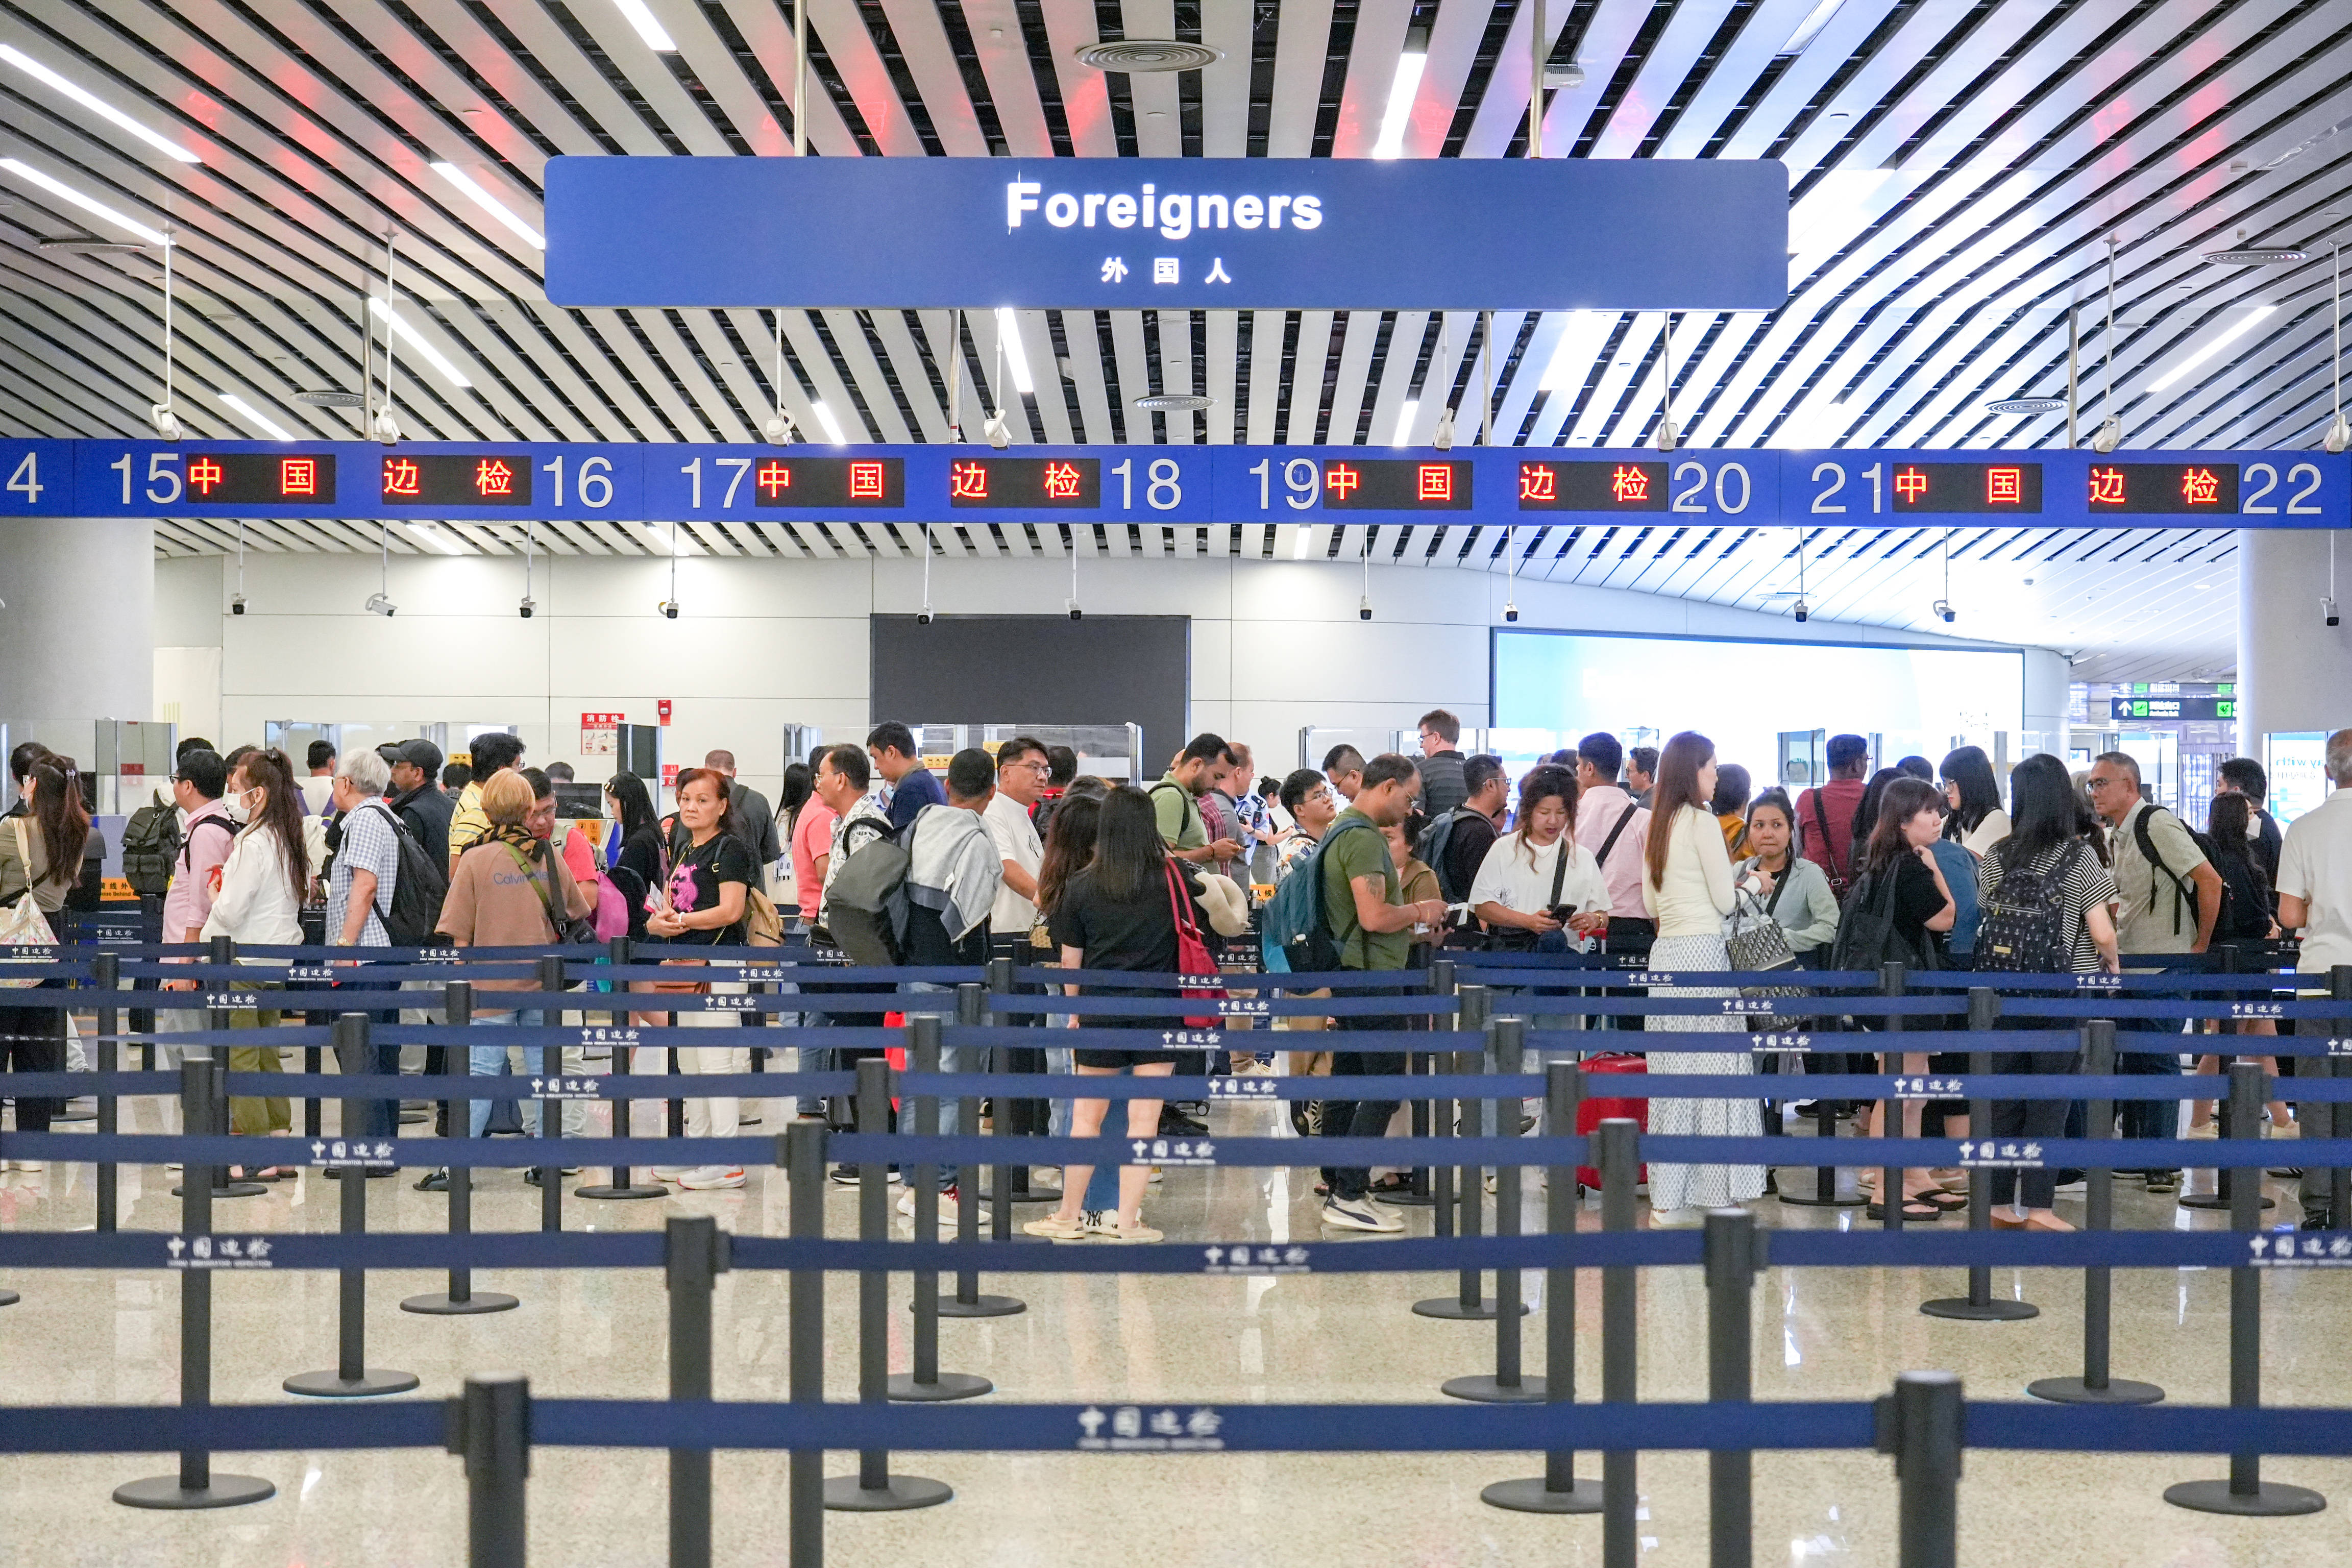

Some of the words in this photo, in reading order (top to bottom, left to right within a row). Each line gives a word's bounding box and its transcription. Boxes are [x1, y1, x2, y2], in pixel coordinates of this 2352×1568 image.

[1008, 182, 1322, 239] Foreigners
[1101, 257, 1231, 284] 外国人
[111, 453, 182, 504] 15
[189, 457, 316, 496] 中国
[384, 458, 513, 496] 边检
[544, 455, 613, 508] 16
[681, 457, 751, 508] 17
[757, 460, 885, 499] 中国
[952, 461, 1081, 499] 边检
[1326, 463, 1453, 501] 中国
[1521, 464, 1650, 502] 边检
[1112, 458, 1182, 510] 18
[1250, 458, 1319, 510] 19
[1672, 461, 1751, 514] 20
[1811, 462, 1881, 513] 21
[1895, 466, 2022, 504] 中国
[2090, 467, 2219, 505] 边检
[2242, 463, 2322, 514] 22
[586, 714, 620, 723] 消防栓
[96, 928, 133, 937] 中国边检
[12, 946, 52, 955] 中国边检
[420, 948, 460, 958] 中国边检
[1217, 953, 1258, 962] 中国边检
[288, 967, 333, 977] 中国边检
[739, 968, 784, 978] 中国边检
[1628, 973, 1673, 983] 中国边检
[1178, 975, 1222, 985] 中国边检
[2076, 975, 2122, 985] 中国边检
[206, 994, 257, 1004] 中国边检
[705, 996, 756, 1007] 中国边检
[1218, 1000, 1269, 1011] 中国边检
[1723, 999, 1773, 1011] 中国边检
[2232, 1003, 2283, 1014] 中国边检
[581, 1028, 640, 1041] 中国边检
[1162, 1031, 1220, 1044] 中国边检
[1752, 1034, 1810, 1047] 中国边检
[531, 1078, 599, 1093] 中国边检
[1894, 1077, 1964, 1091] 中国边检
[310, 1140, 395, 1157] 中国边检
[1958, 1141, 2043, 1158] 中国边检
